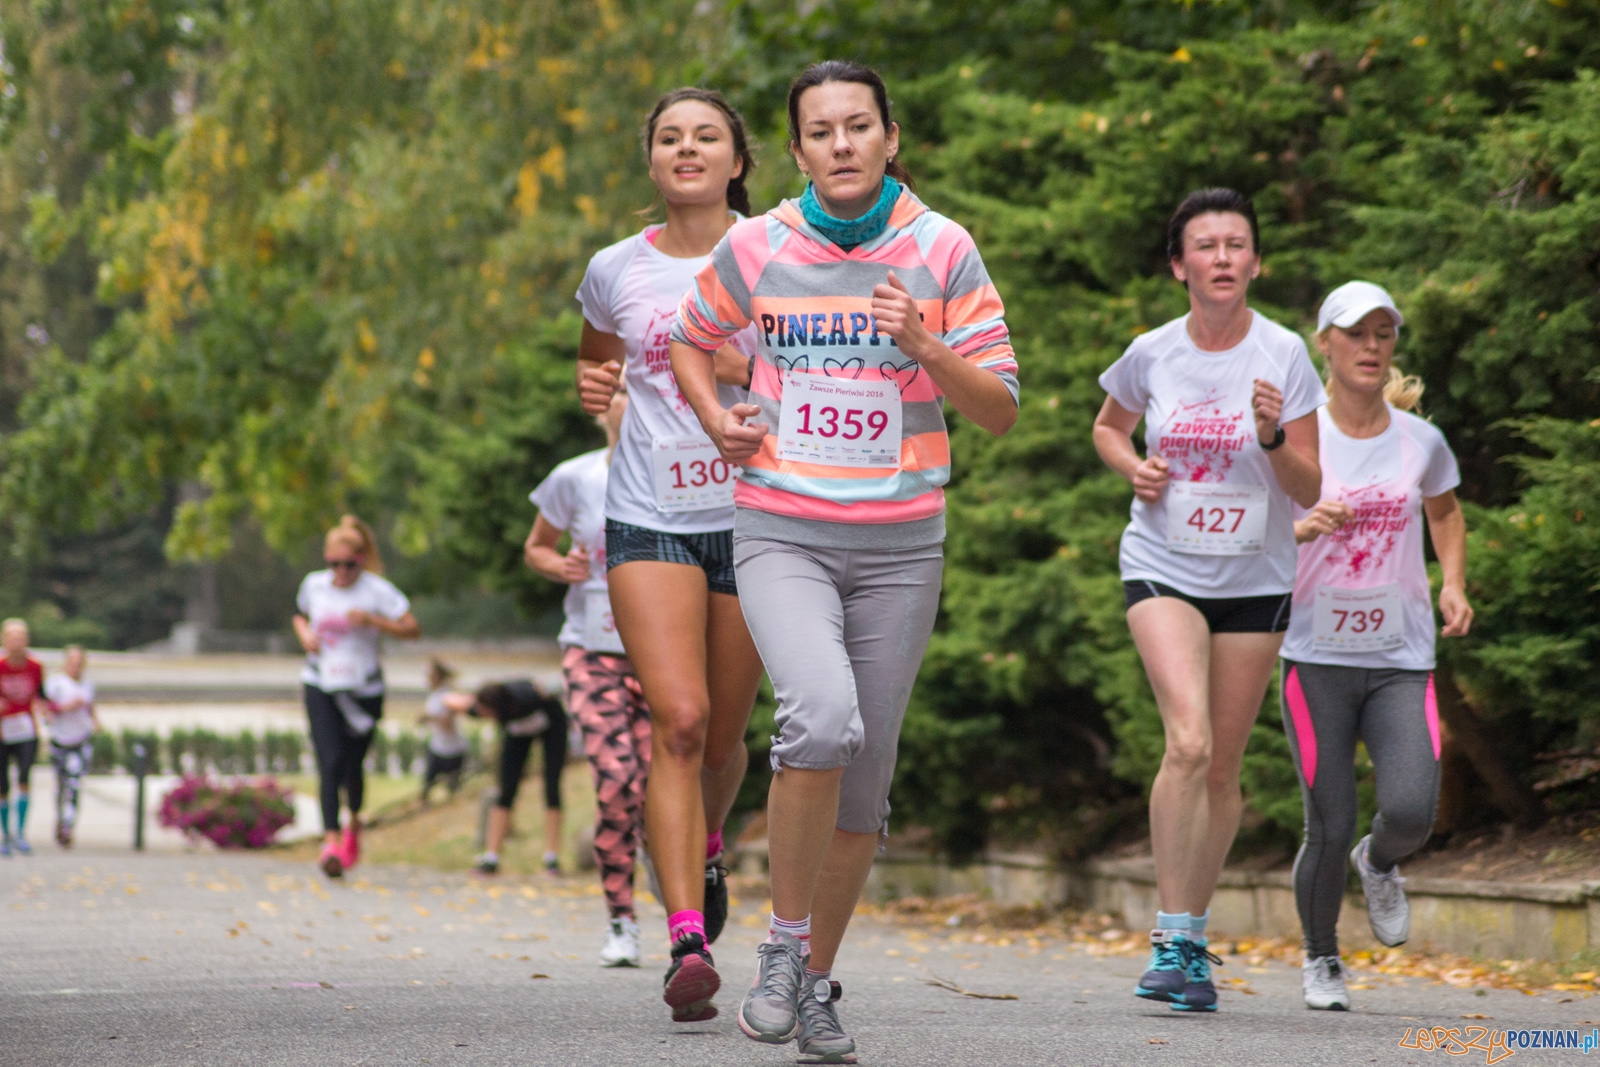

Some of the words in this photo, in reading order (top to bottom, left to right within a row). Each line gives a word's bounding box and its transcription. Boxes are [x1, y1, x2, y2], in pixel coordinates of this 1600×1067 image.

[809, 383, 834, 394] Zawsze
[835, 387, 865, 397] Pier(w)si
[866, 390, 884, 398] 2016
[797, 402, 889, 447] 1359
[1170, 422, 1236, 436] zawsze
[1186, 507, 1247, 533] 427
[1331, 607, 1385, 633] 739
